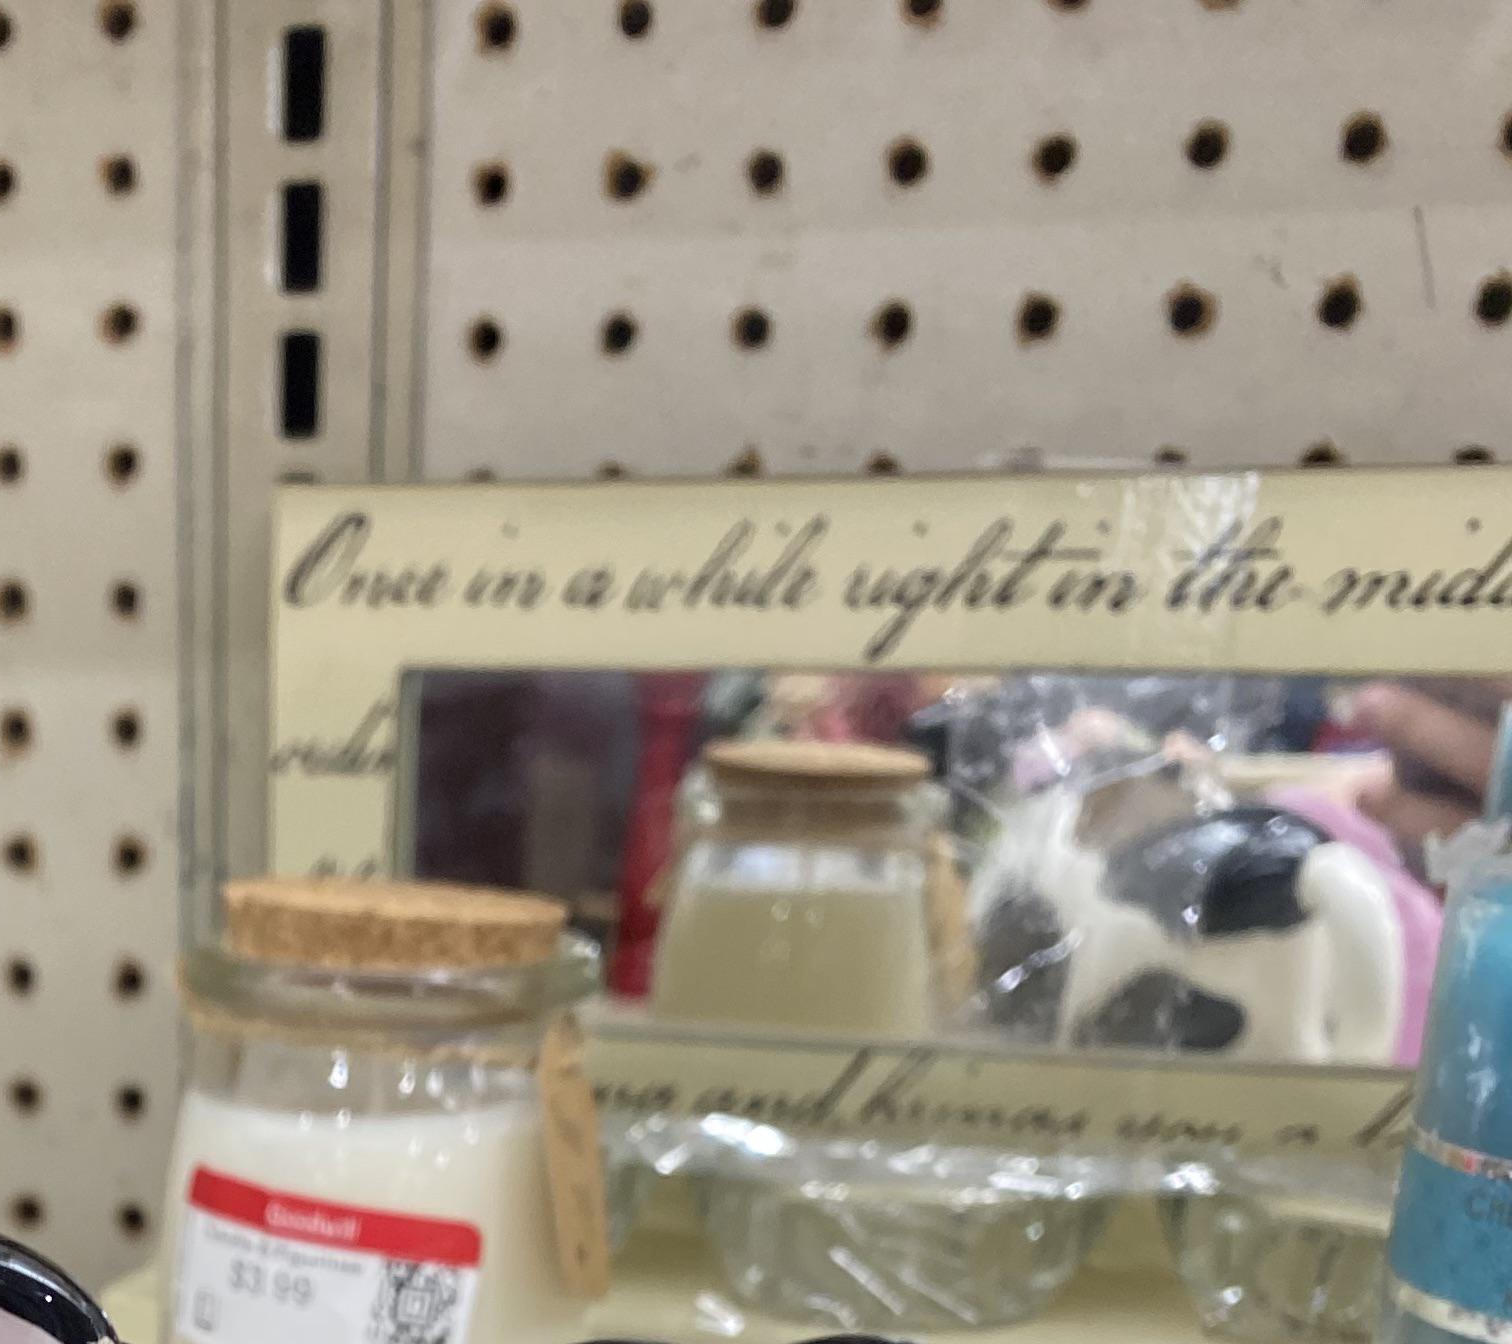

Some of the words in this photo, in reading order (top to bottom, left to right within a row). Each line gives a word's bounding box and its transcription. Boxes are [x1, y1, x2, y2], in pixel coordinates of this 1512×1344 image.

[284, 512, 450, 608] Once
[462, 518, 546, 609] in
[561, 565, 616, 608] a
[624, 512, 829, 613] while
[842, 515, 1078, 662] right
[1046, 517, 1144, 614] in
[1165, 514, 1292, 613] the
